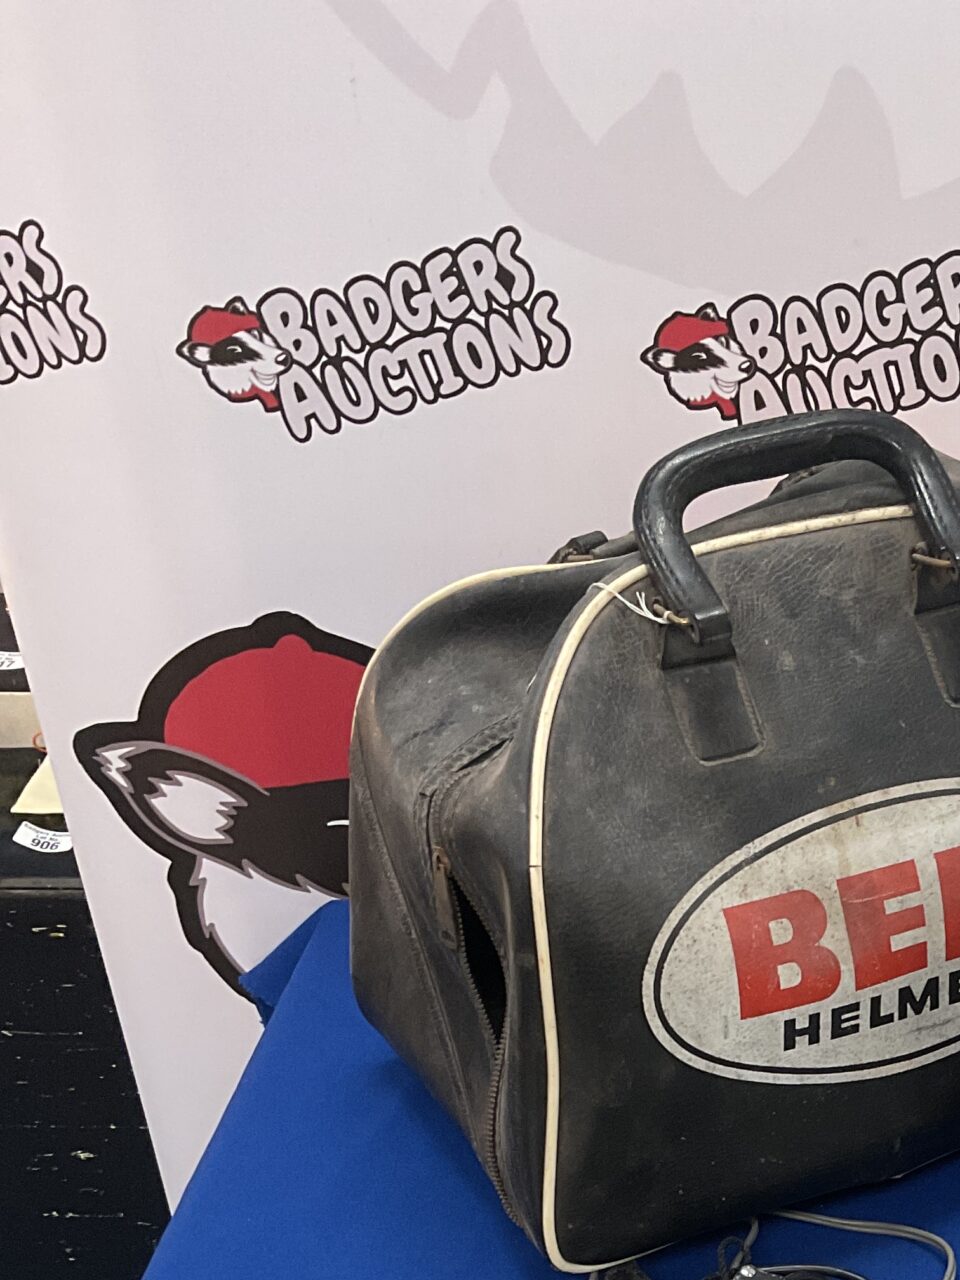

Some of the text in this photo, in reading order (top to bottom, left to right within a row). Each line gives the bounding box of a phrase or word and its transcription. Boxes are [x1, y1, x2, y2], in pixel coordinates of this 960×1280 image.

[0, 219, 63, 308] RS
[258, 225, 533, 367] BADGERS
[278, 290, 570, 442] AUCTIONS
[31, 838, 60, 851] 906
